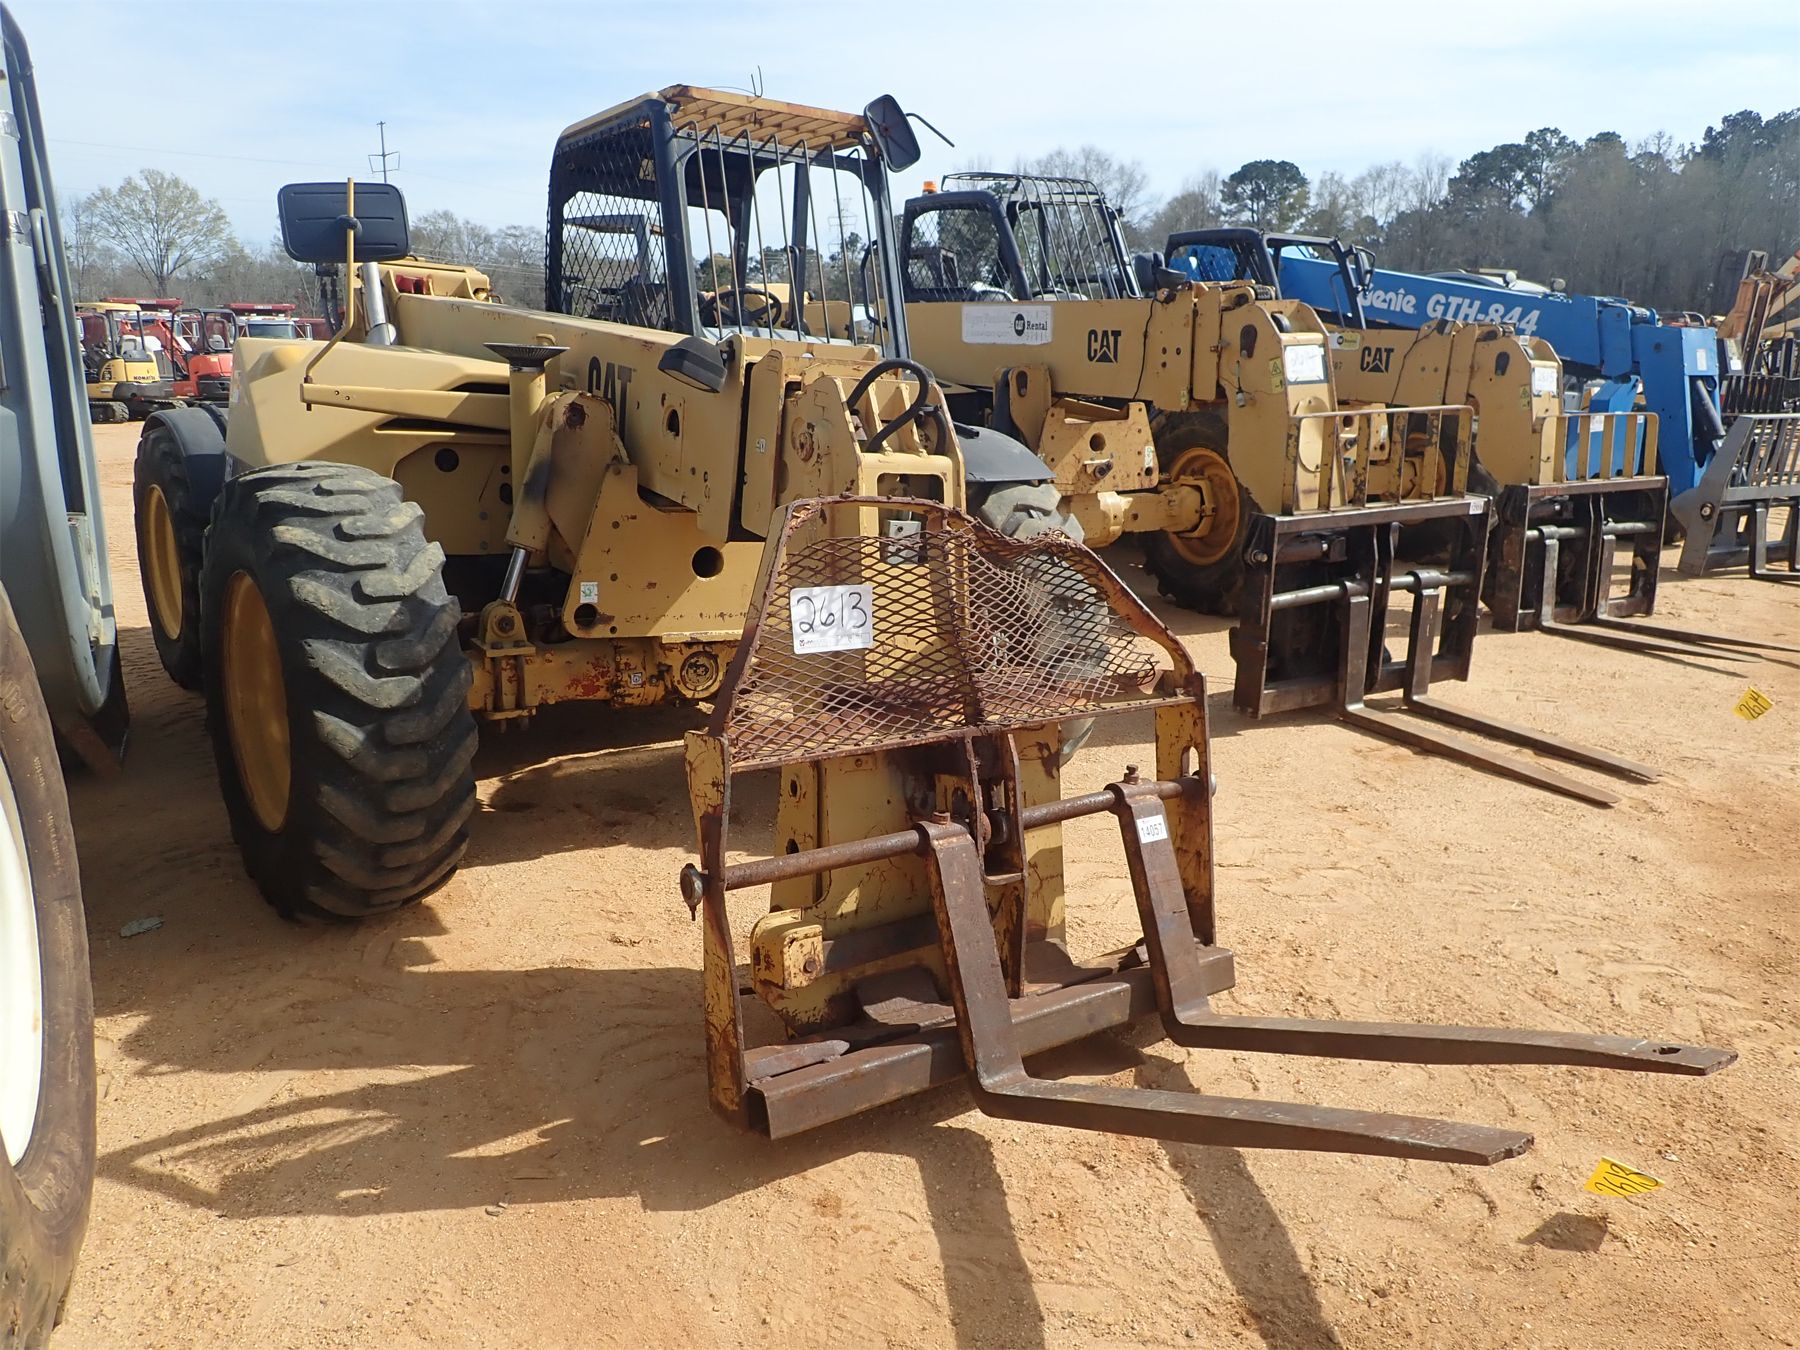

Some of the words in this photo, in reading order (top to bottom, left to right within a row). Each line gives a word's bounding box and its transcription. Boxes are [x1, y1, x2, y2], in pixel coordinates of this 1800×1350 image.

[1026, 320, 1048, 331] Rental
[1426, 293, 1541, 335] GTH-844
[1087, 329, 1122, 364] CAT
[1361, 346, 1395, 373] CAT
[796, 591, 868, 634] 2613
[1739, 690, 1769, 719] 2614
[1594, 1163, 1659, 1198] 2613
